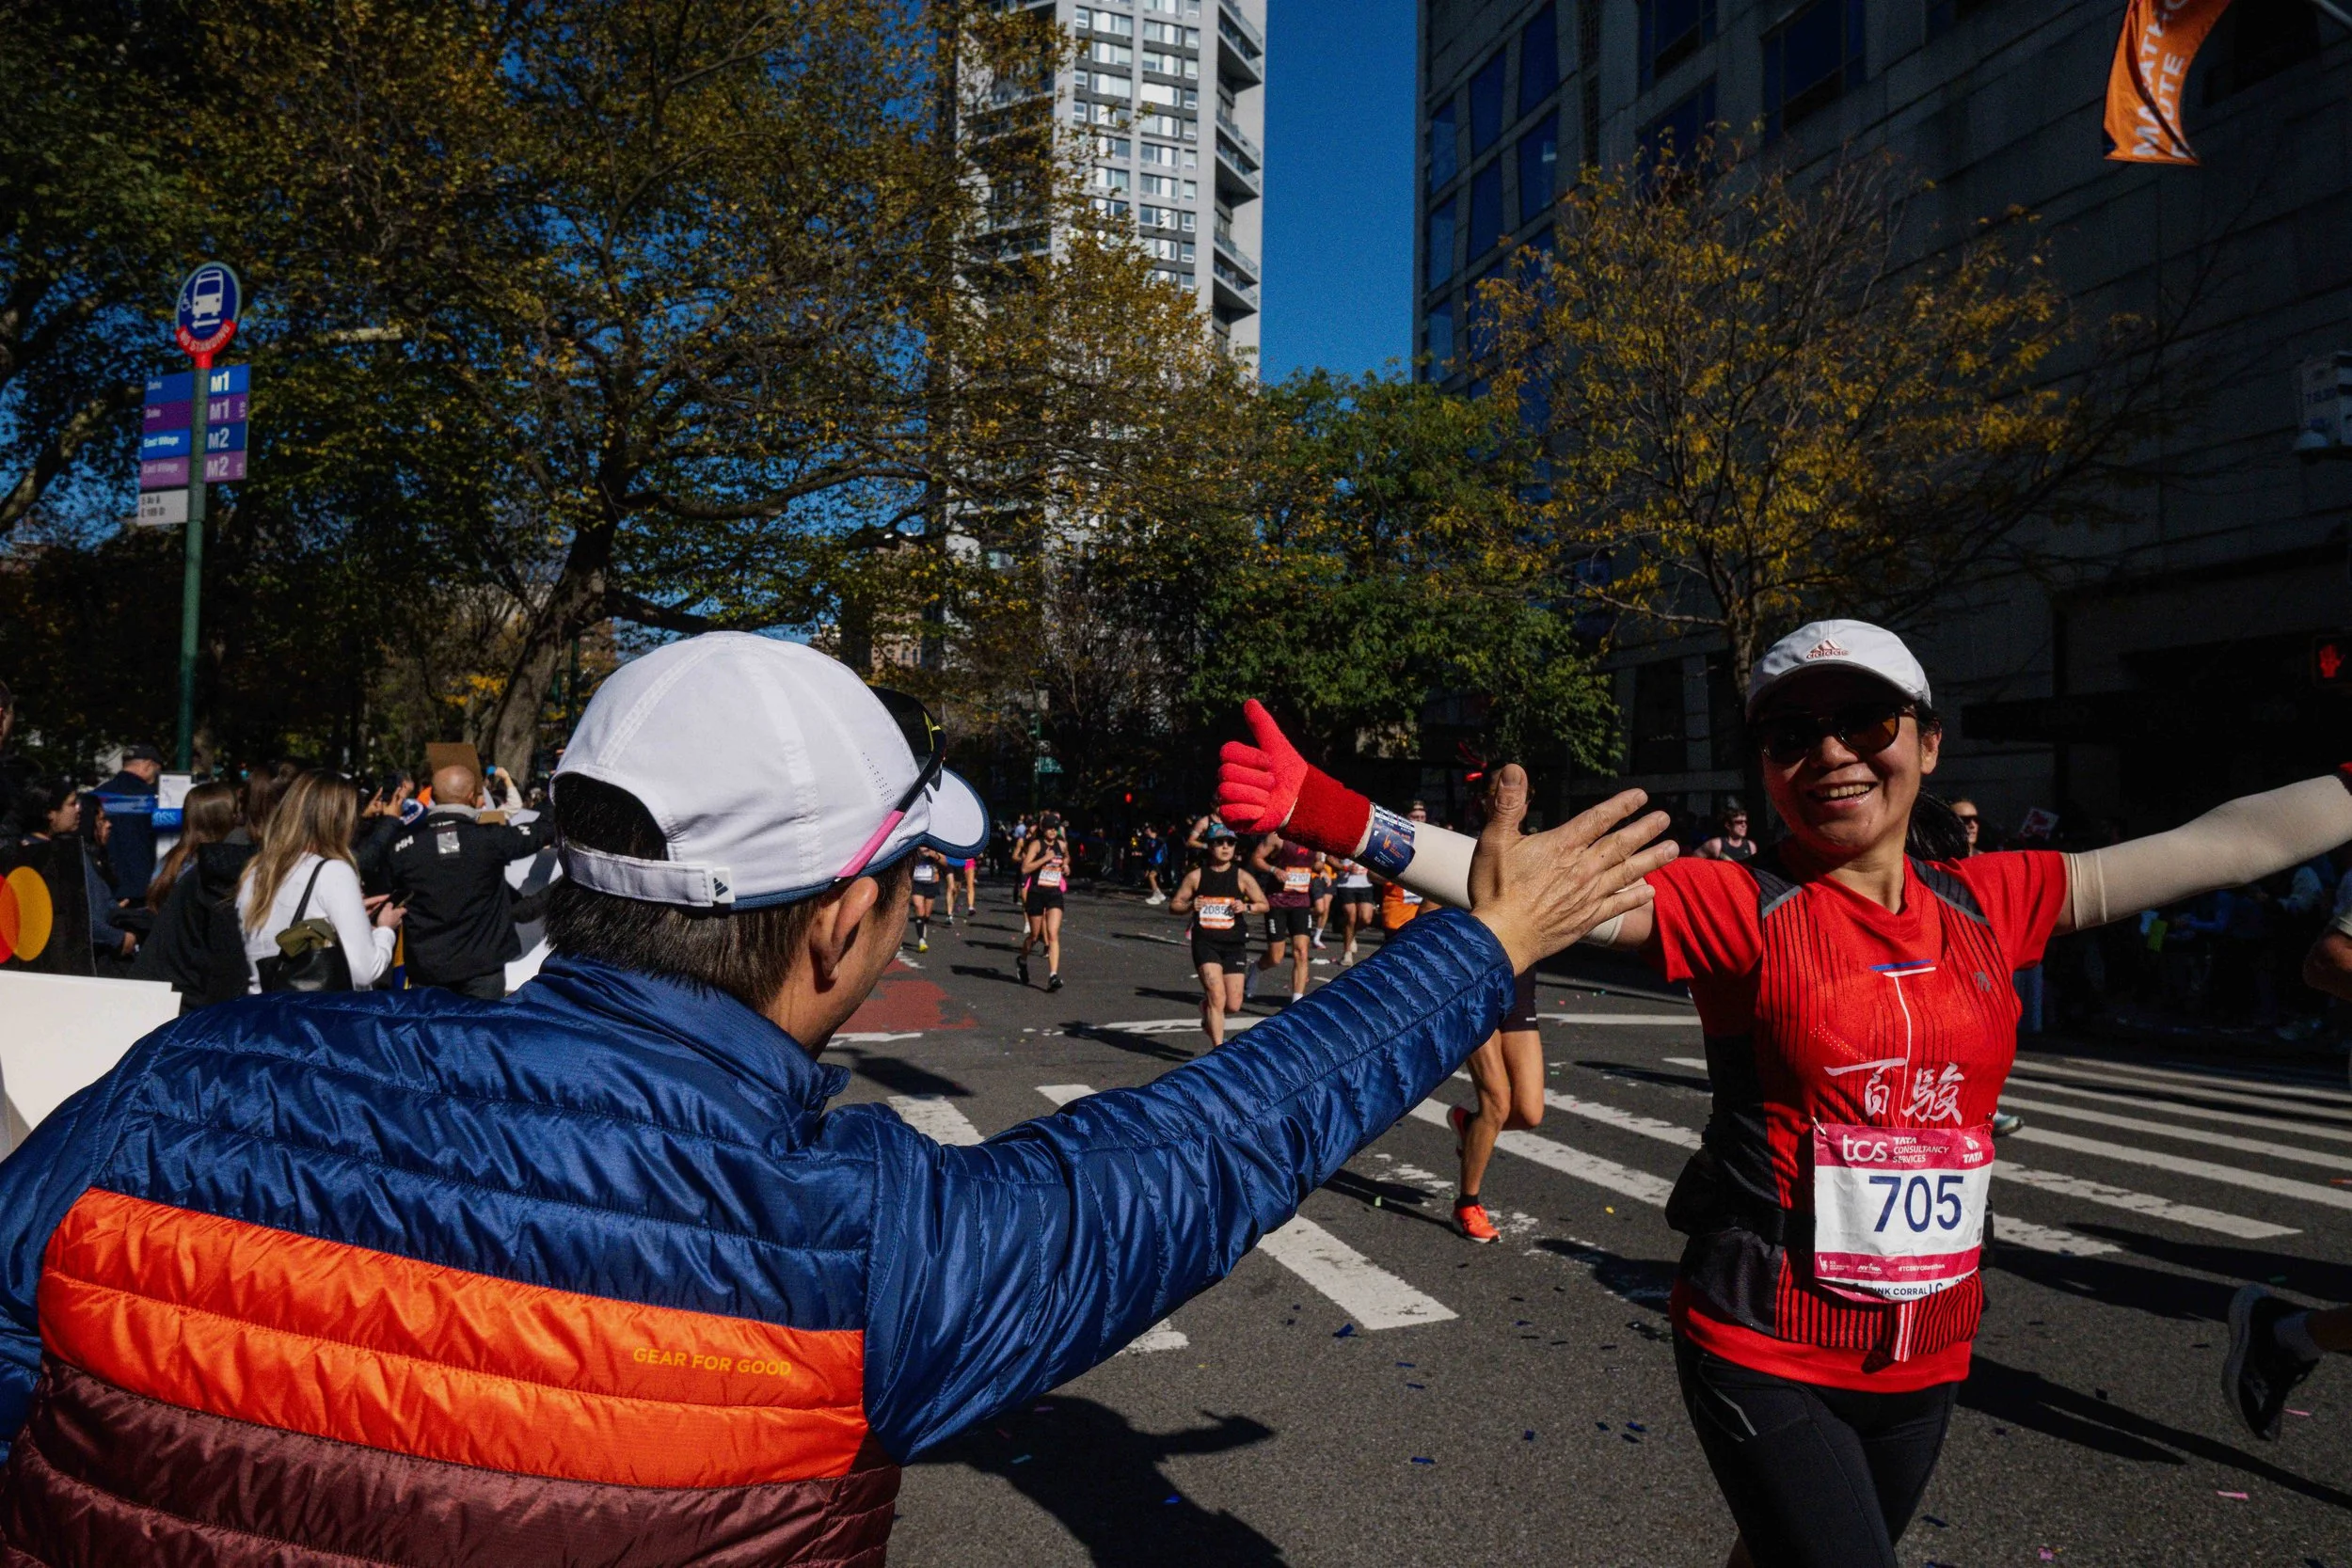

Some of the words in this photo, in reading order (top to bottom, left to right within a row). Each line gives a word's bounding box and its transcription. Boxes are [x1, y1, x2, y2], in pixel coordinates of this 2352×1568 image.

[211, 372, 230, 392] M1
[210, 399, 230, 420] M1
[208, 427, 229, 449] M2
[206, 457, 229, 478] M2
[1806, 648, 1851, 659] adidas
[1842, 1133, 1888, 1163] tcs
[1892, 1136, 1917, 1146] TATA
[1893, 1145, 1950, 1155] CONSULTANCY
[1892, 1154, 1927, 1164] SERVICES
[1963, 1151, 1983, 1164] TATA
[1868, 1174, 1964, 1234] 705
[1893, 1287, 1928, 1296] CORRAL
[633, 1347, 688, 1368] GEAR
[691, 1354, 732, 1372] FOR
[737, 1359, 792, 1376] GOOD
